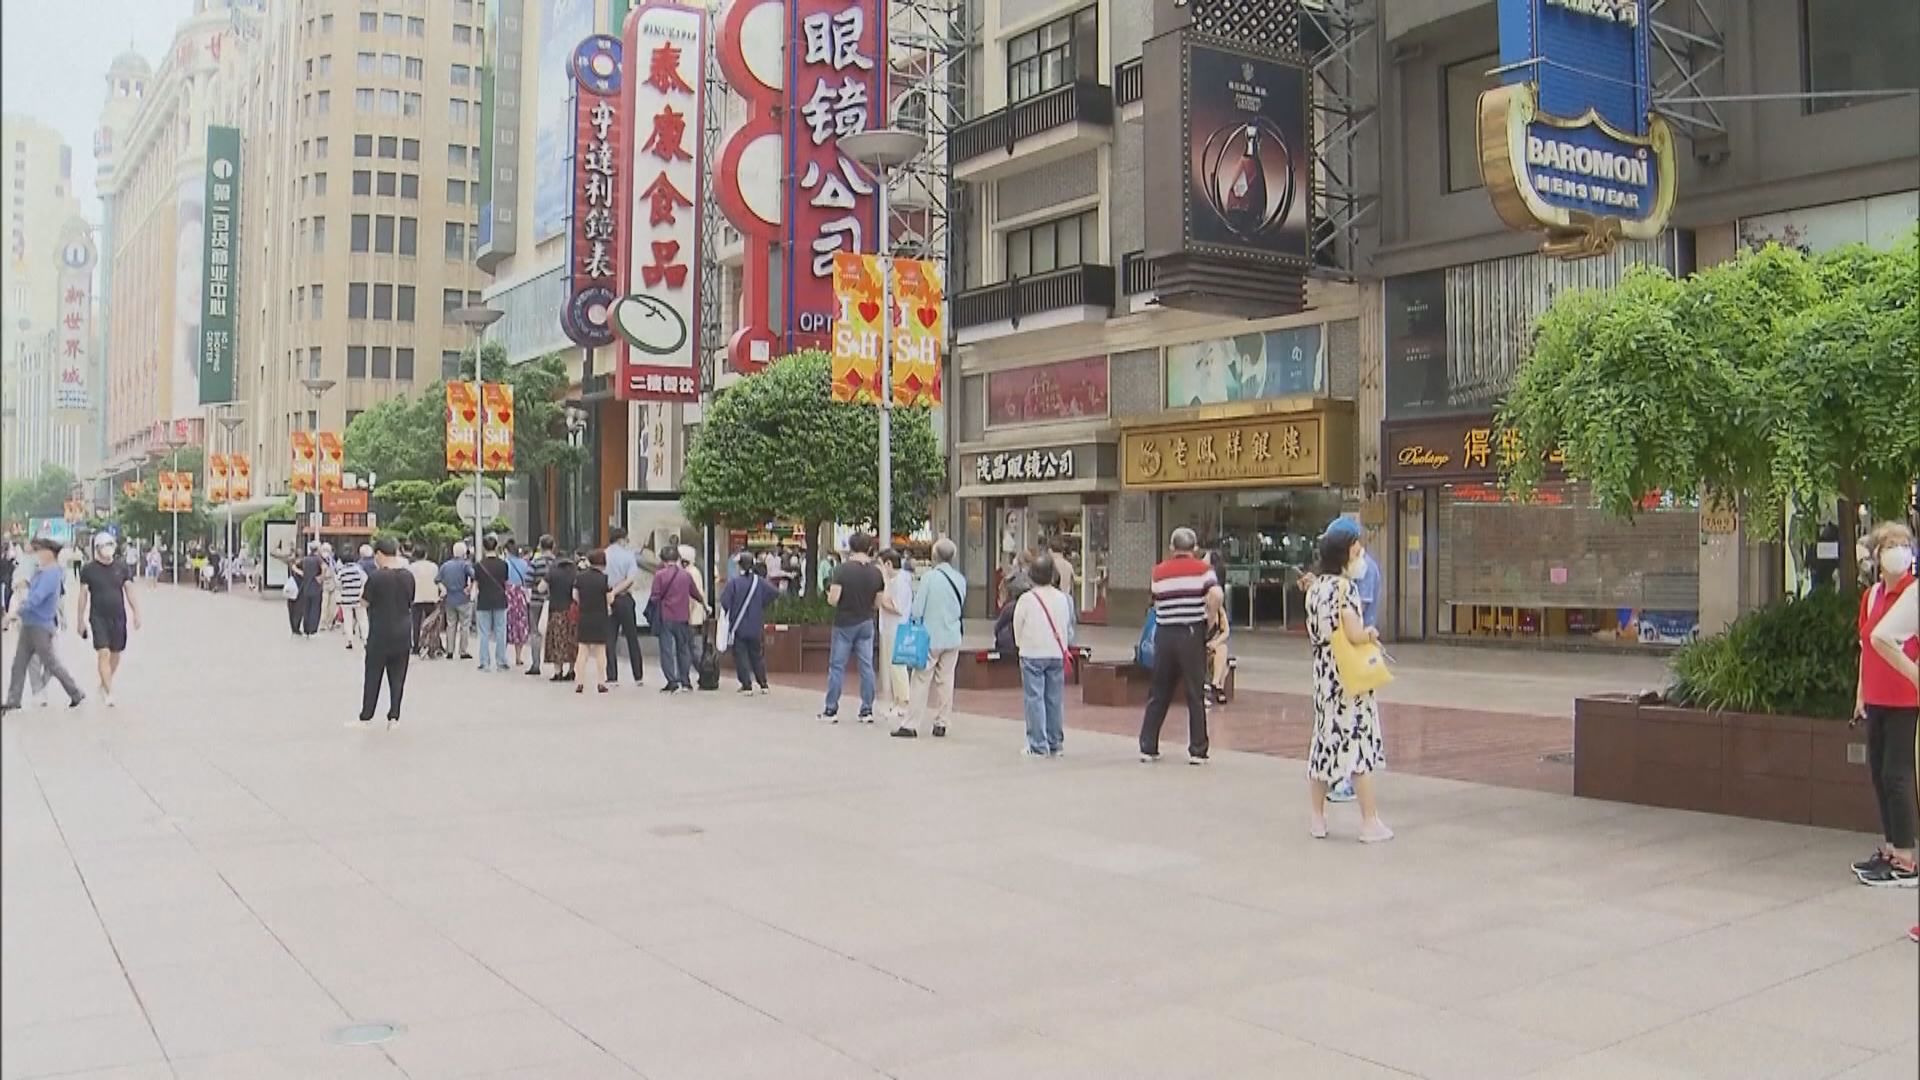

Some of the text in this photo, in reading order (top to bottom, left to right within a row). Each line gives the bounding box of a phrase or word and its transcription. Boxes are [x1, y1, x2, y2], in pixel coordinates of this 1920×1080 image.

[640, 41, 695, 290] 泰康食品
[800, 5, 874, 278] 眼镜公司
[1527, 135, 1648, 186] BAROMON
[1589, 185, 1640, 209] WEAR
